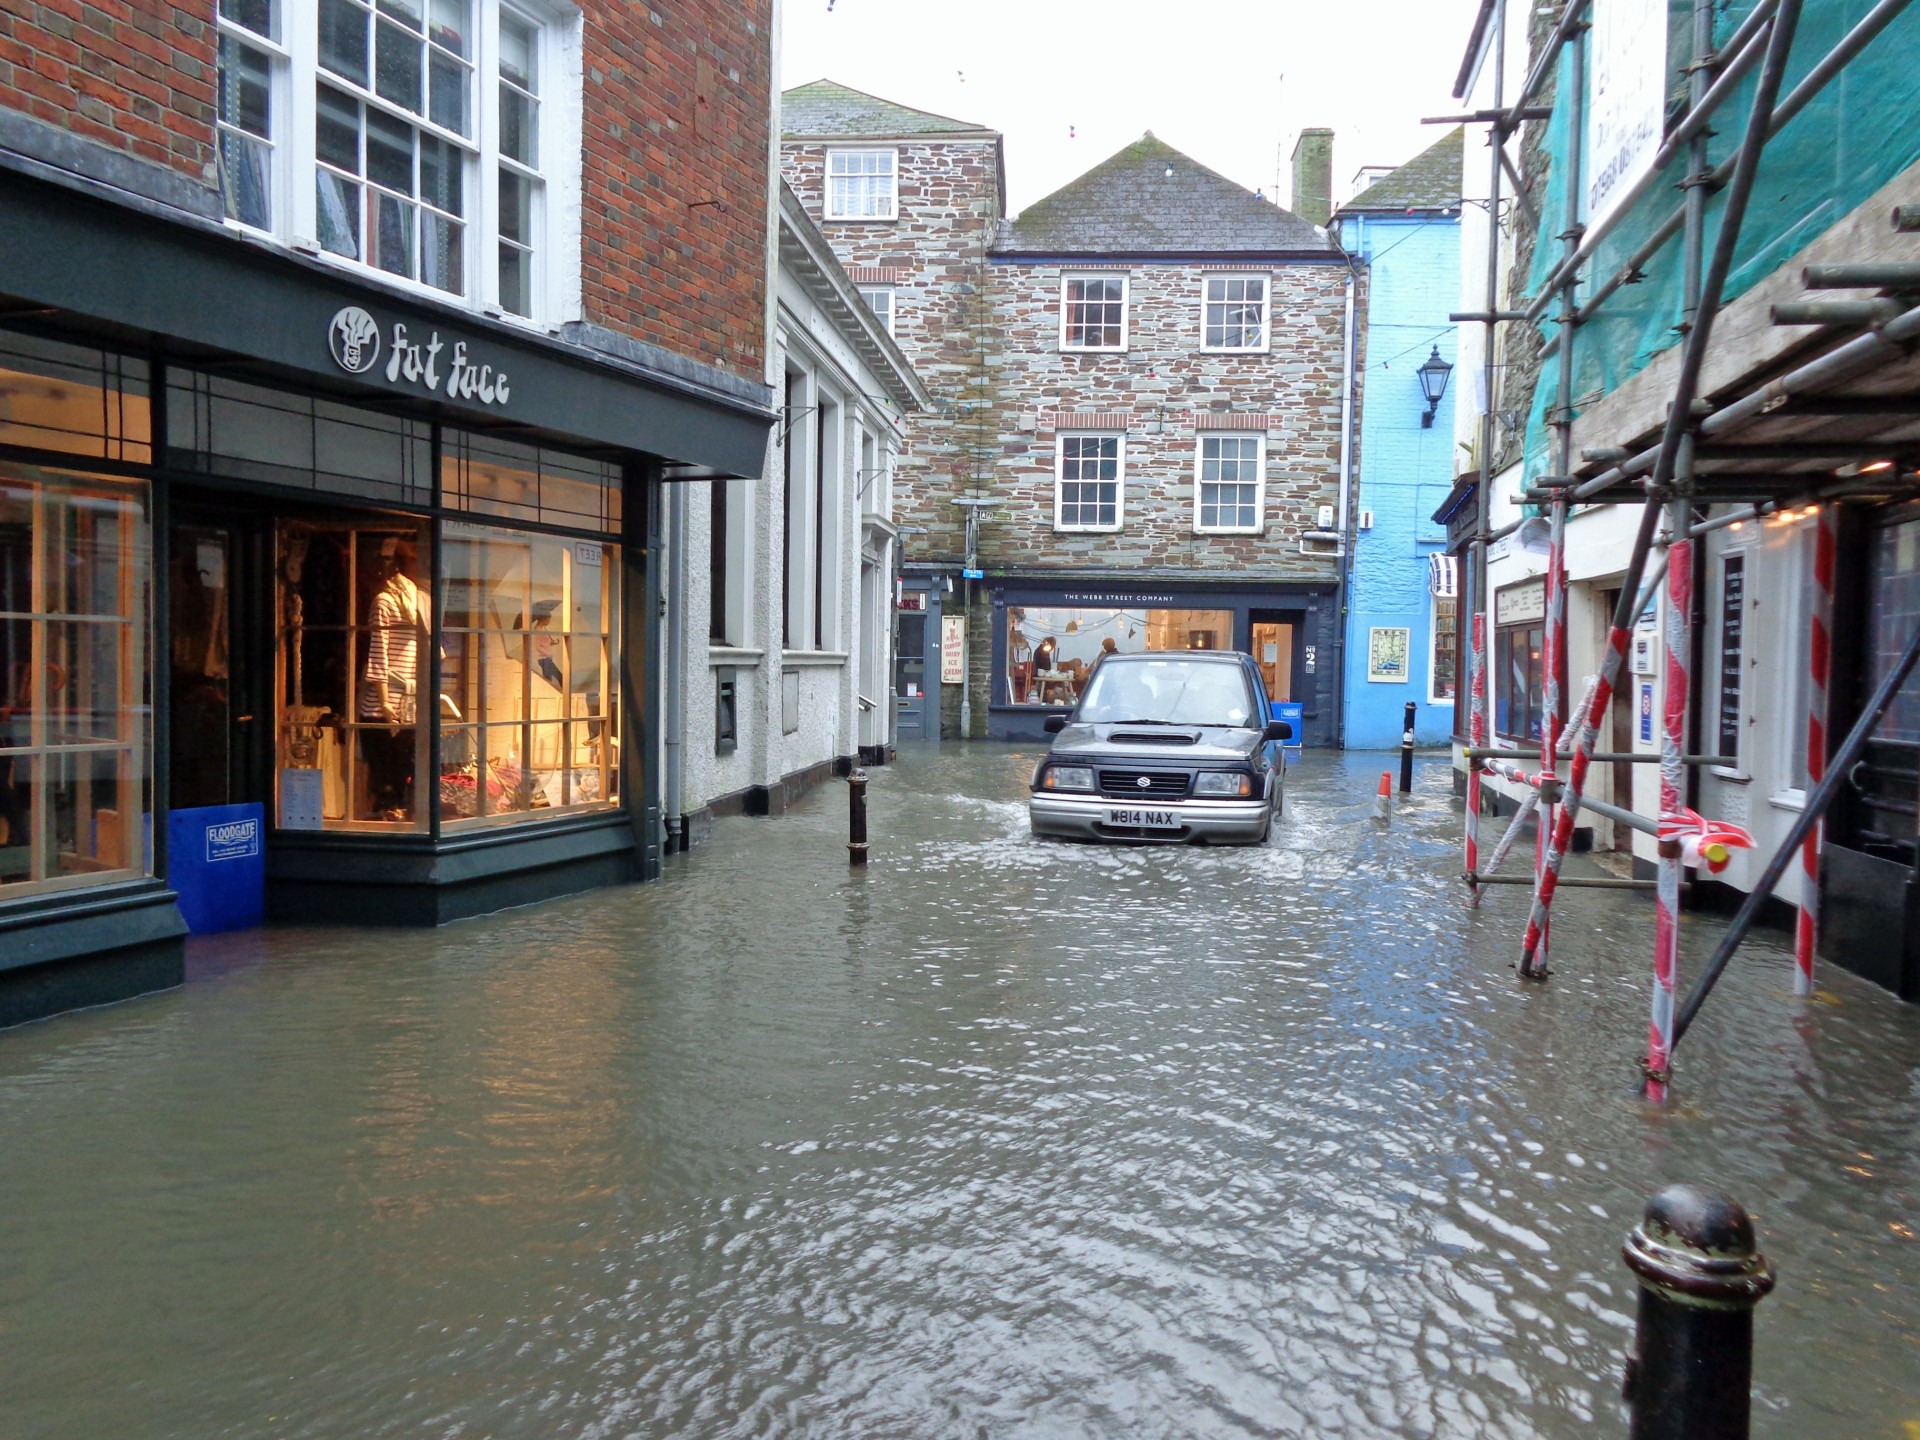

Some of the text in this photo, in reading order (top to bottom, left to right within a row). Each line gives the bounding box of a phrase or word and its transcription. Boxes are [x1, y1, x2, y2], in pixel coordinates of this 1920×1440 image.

[386, 323, 510, 404] fat face
[1306, 653, 1315, 665] 2
[1111, 810, 1173, 825] W814 NAX
[209, 822, 255, 841] FLOODGATE
